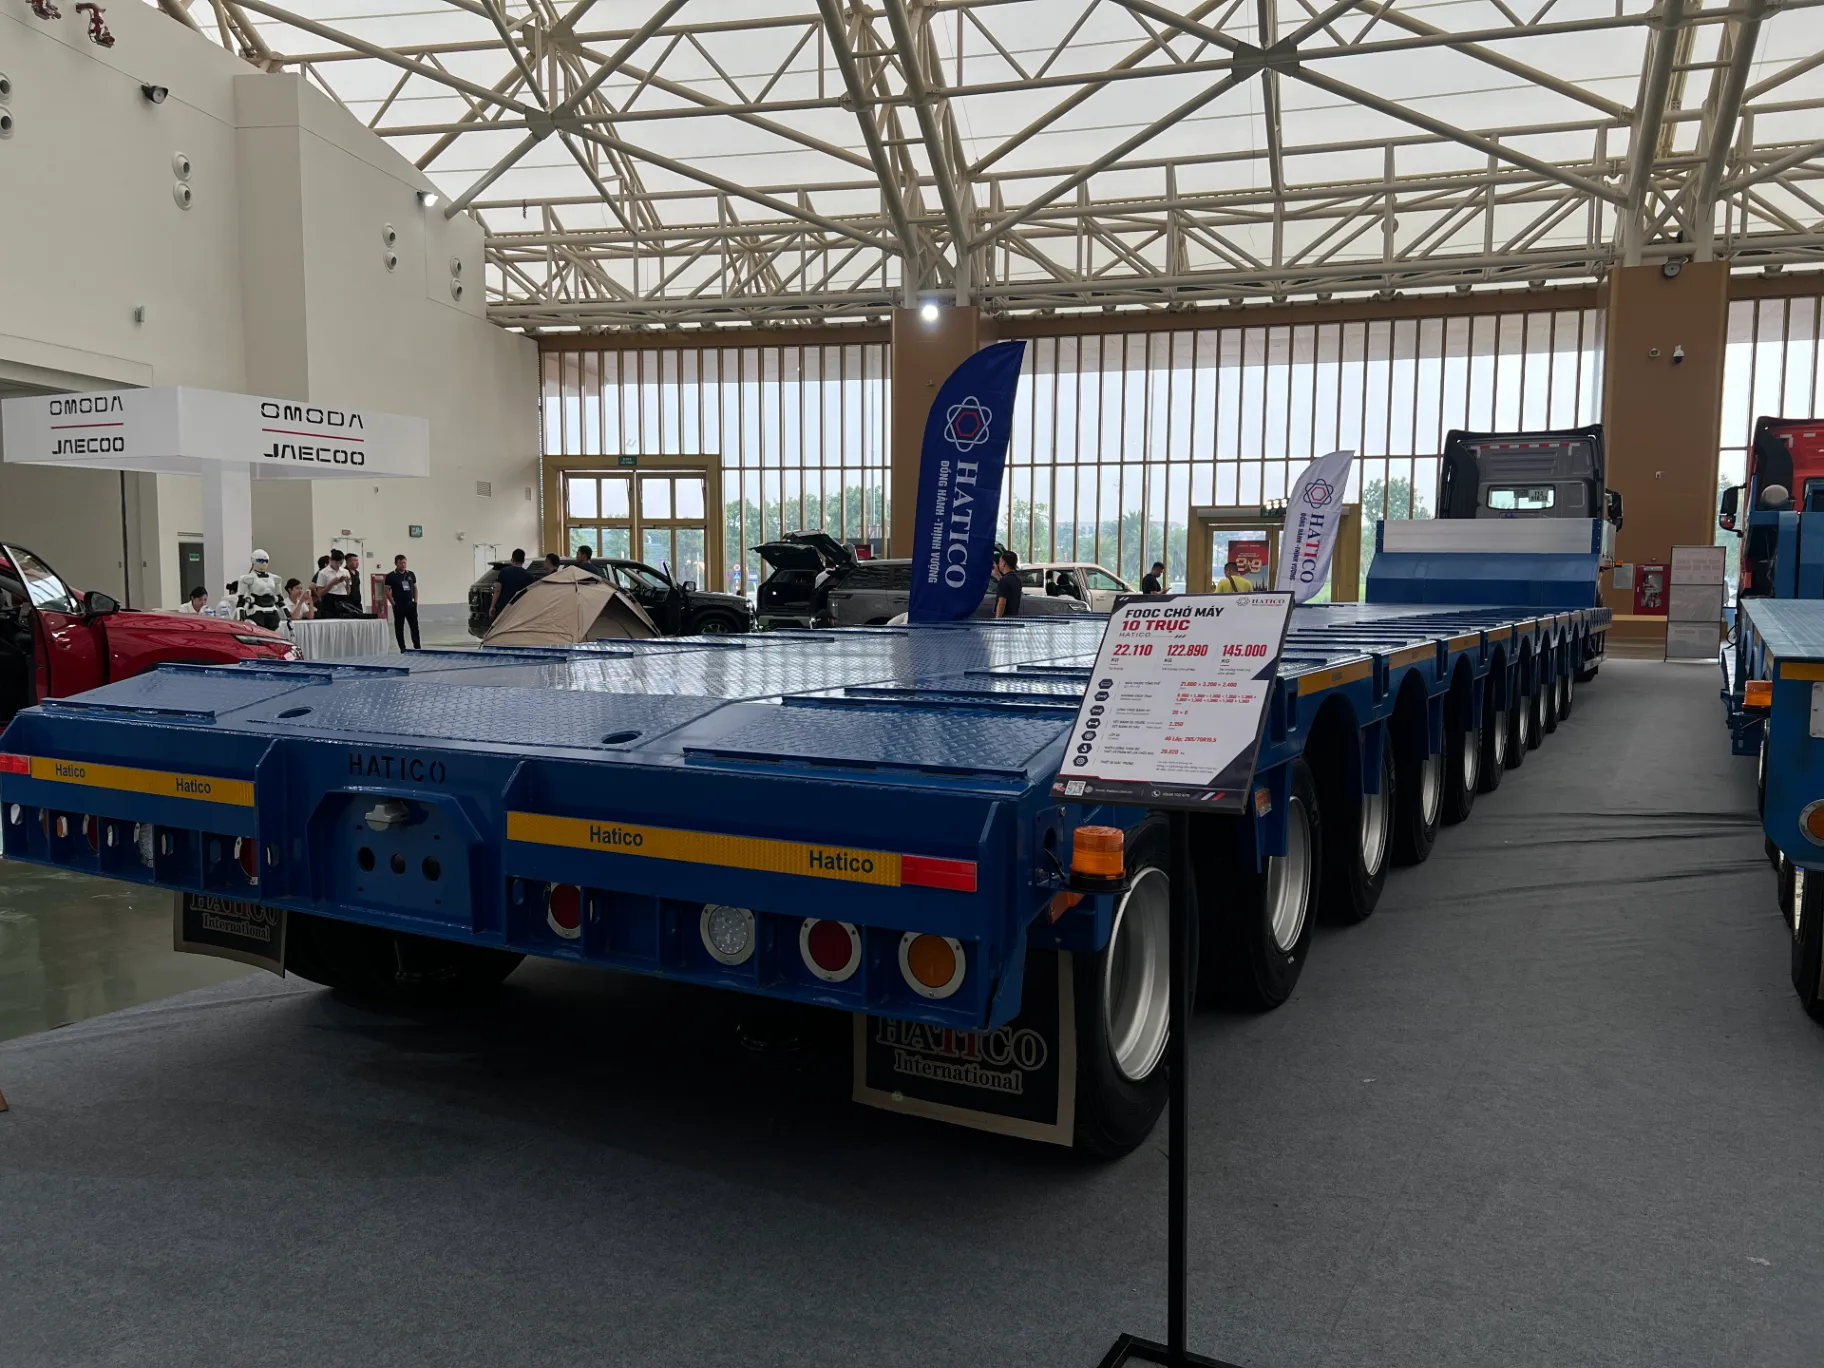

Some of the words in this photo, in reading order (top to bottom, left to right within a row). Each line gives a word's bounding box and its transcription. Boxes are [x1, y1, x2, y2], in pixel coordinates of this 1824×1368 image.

[50, 395, 124, 415] OMODA
[260, 402, 364, 429] OMODA
[52, 436, 124, 454] JAECOO
[264, 443, 365, 466] JAECOO
[935, 489, 947, 515] HÀNH
[944, 459, 979, 588] HATICO
[1300, 513, 1324, 583] HATICO
[1125, 609, 1160, 618] FOOC
[1164, 607, 1193, 618] CHỞ
[1195, 605, 1224, 617] MÁY
[1122, 620, 1140, 631] 10
[1145, 620, 1191, 633] TRỤC
[1113, 644, 1153, 656] 22.110
[1167, 645, 1208, 656] 122.890
[1222, 644, 1268, 657] 145.000
[55, 763, 86, 779] Hatico
[175, 777, 211, 794] Hatico
[349, 752, 446, 785] HATICO
[589, 825, 644, 848] Hatico
[808, 847, 875, 875] Hatico
[202, 913, 270, 943] International
[894, 1048, 1024, 1096] International
